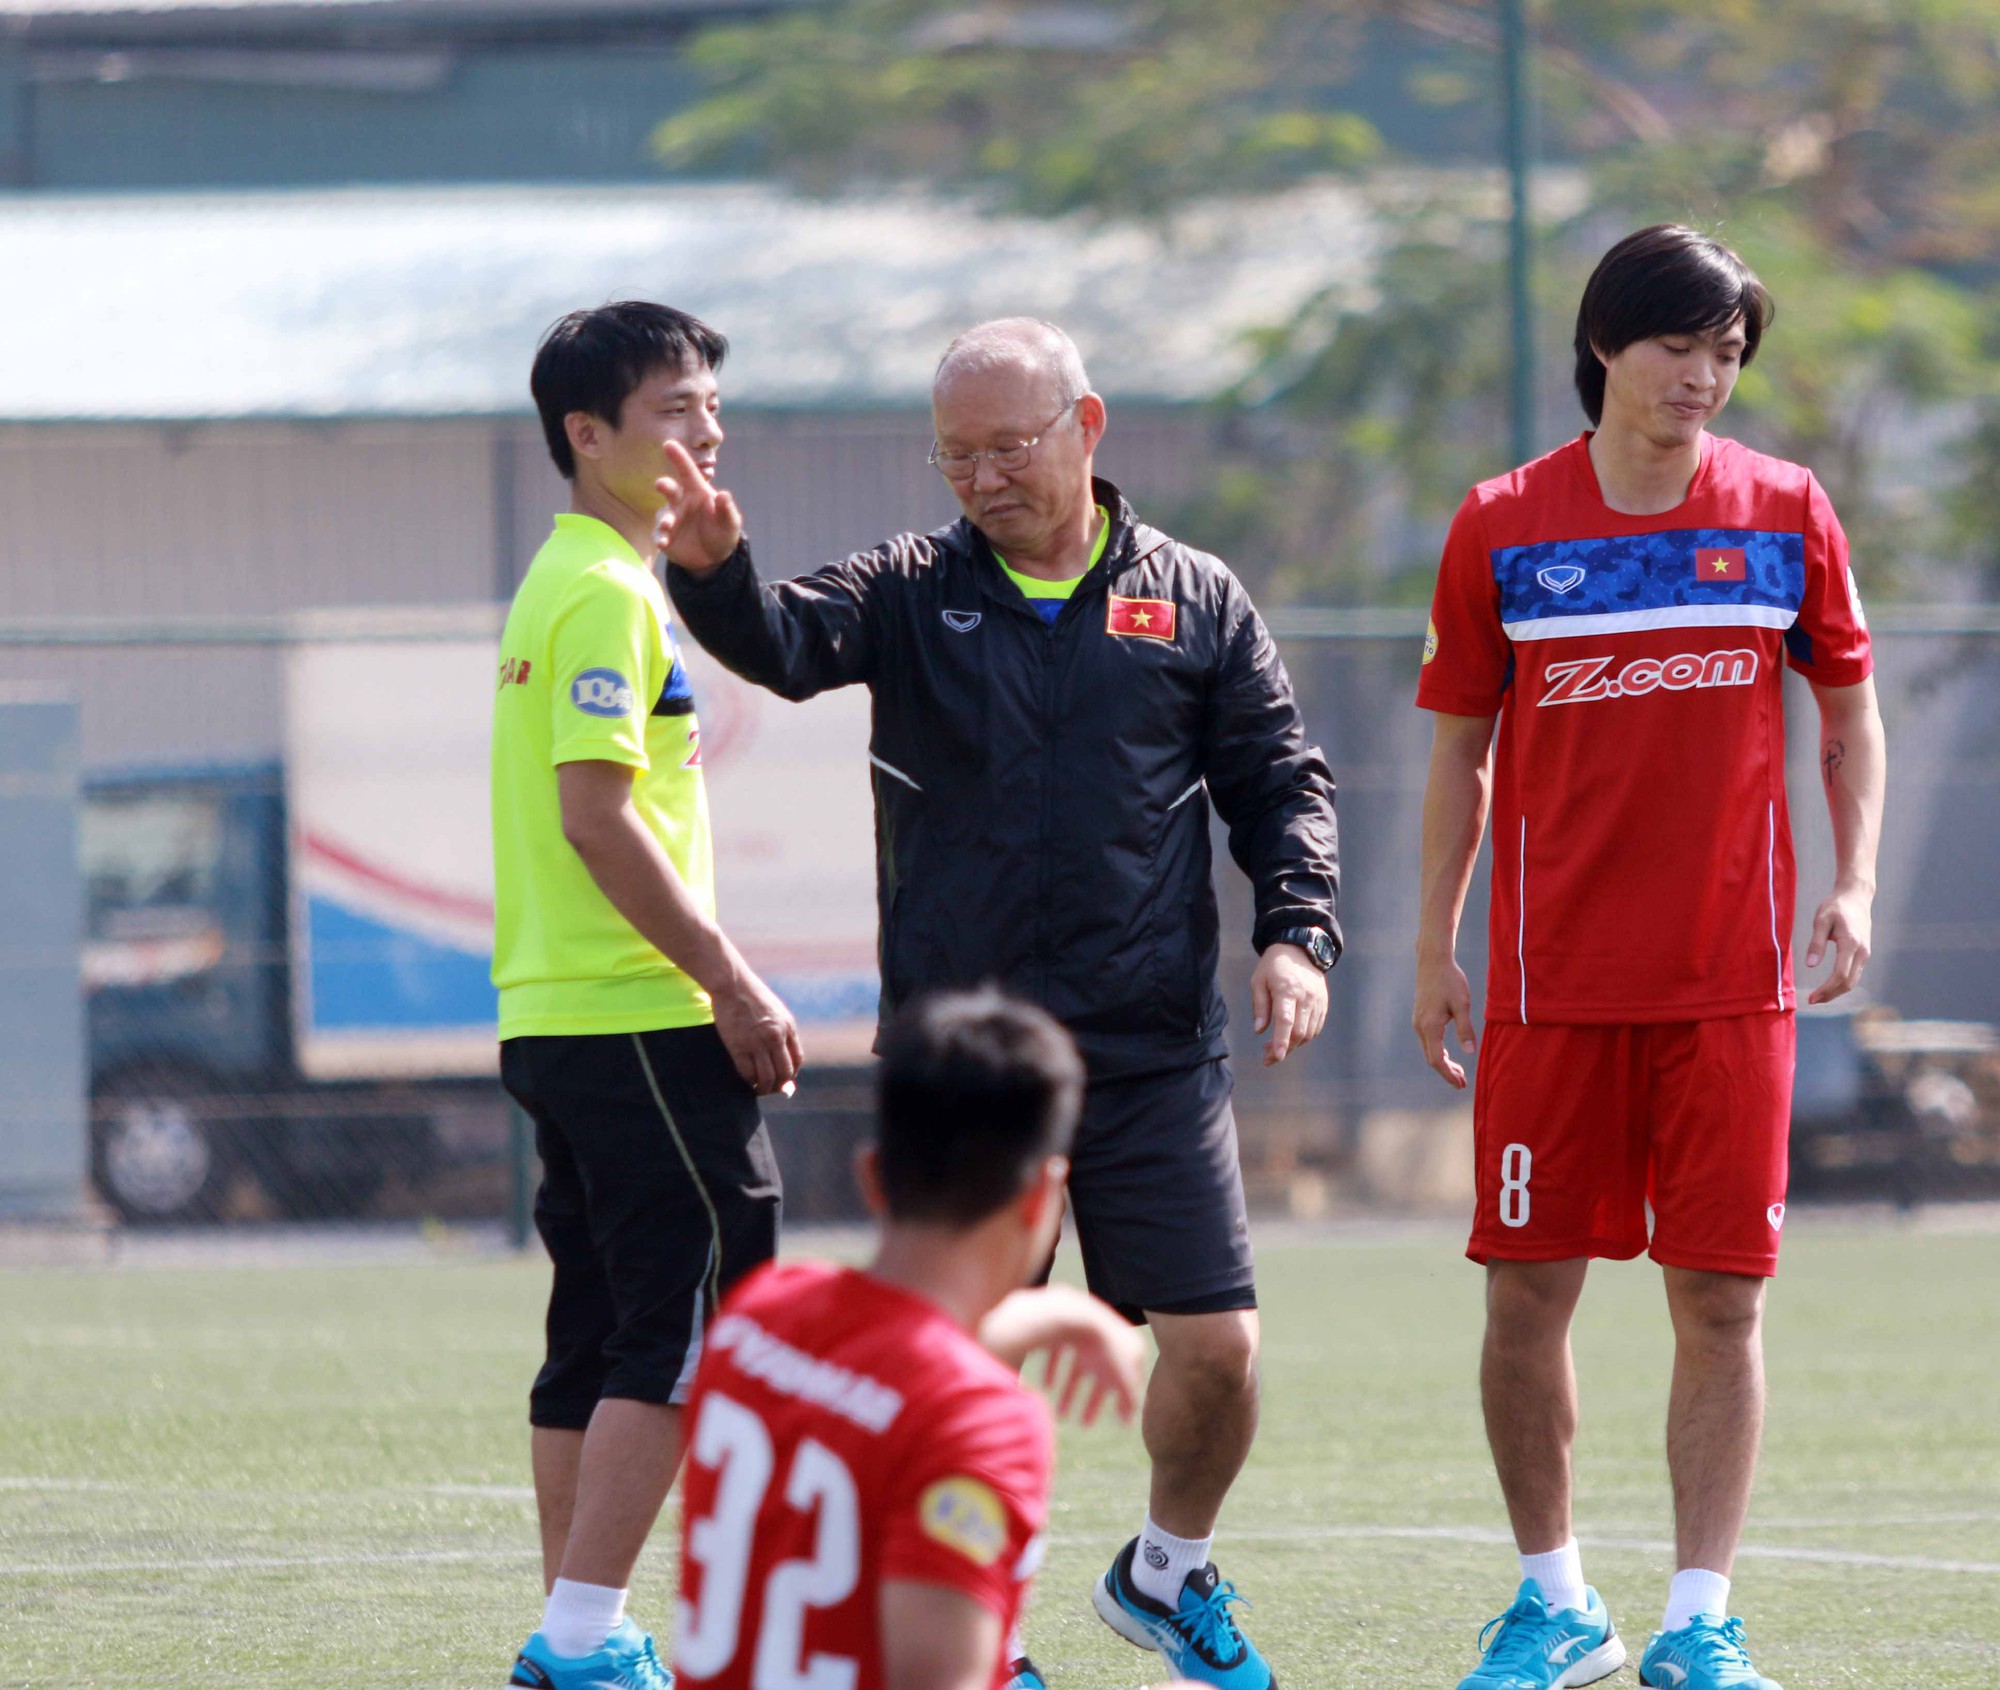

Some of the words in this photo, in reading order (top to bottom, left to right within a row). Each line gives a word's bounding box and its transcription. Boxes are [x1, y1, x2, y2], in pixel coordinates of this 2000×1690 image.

[1536, 648, 1759, 707] Z.com
[1499, 1143, 1532, 1227] 8
[672, 1390, 860, 1690] 32
